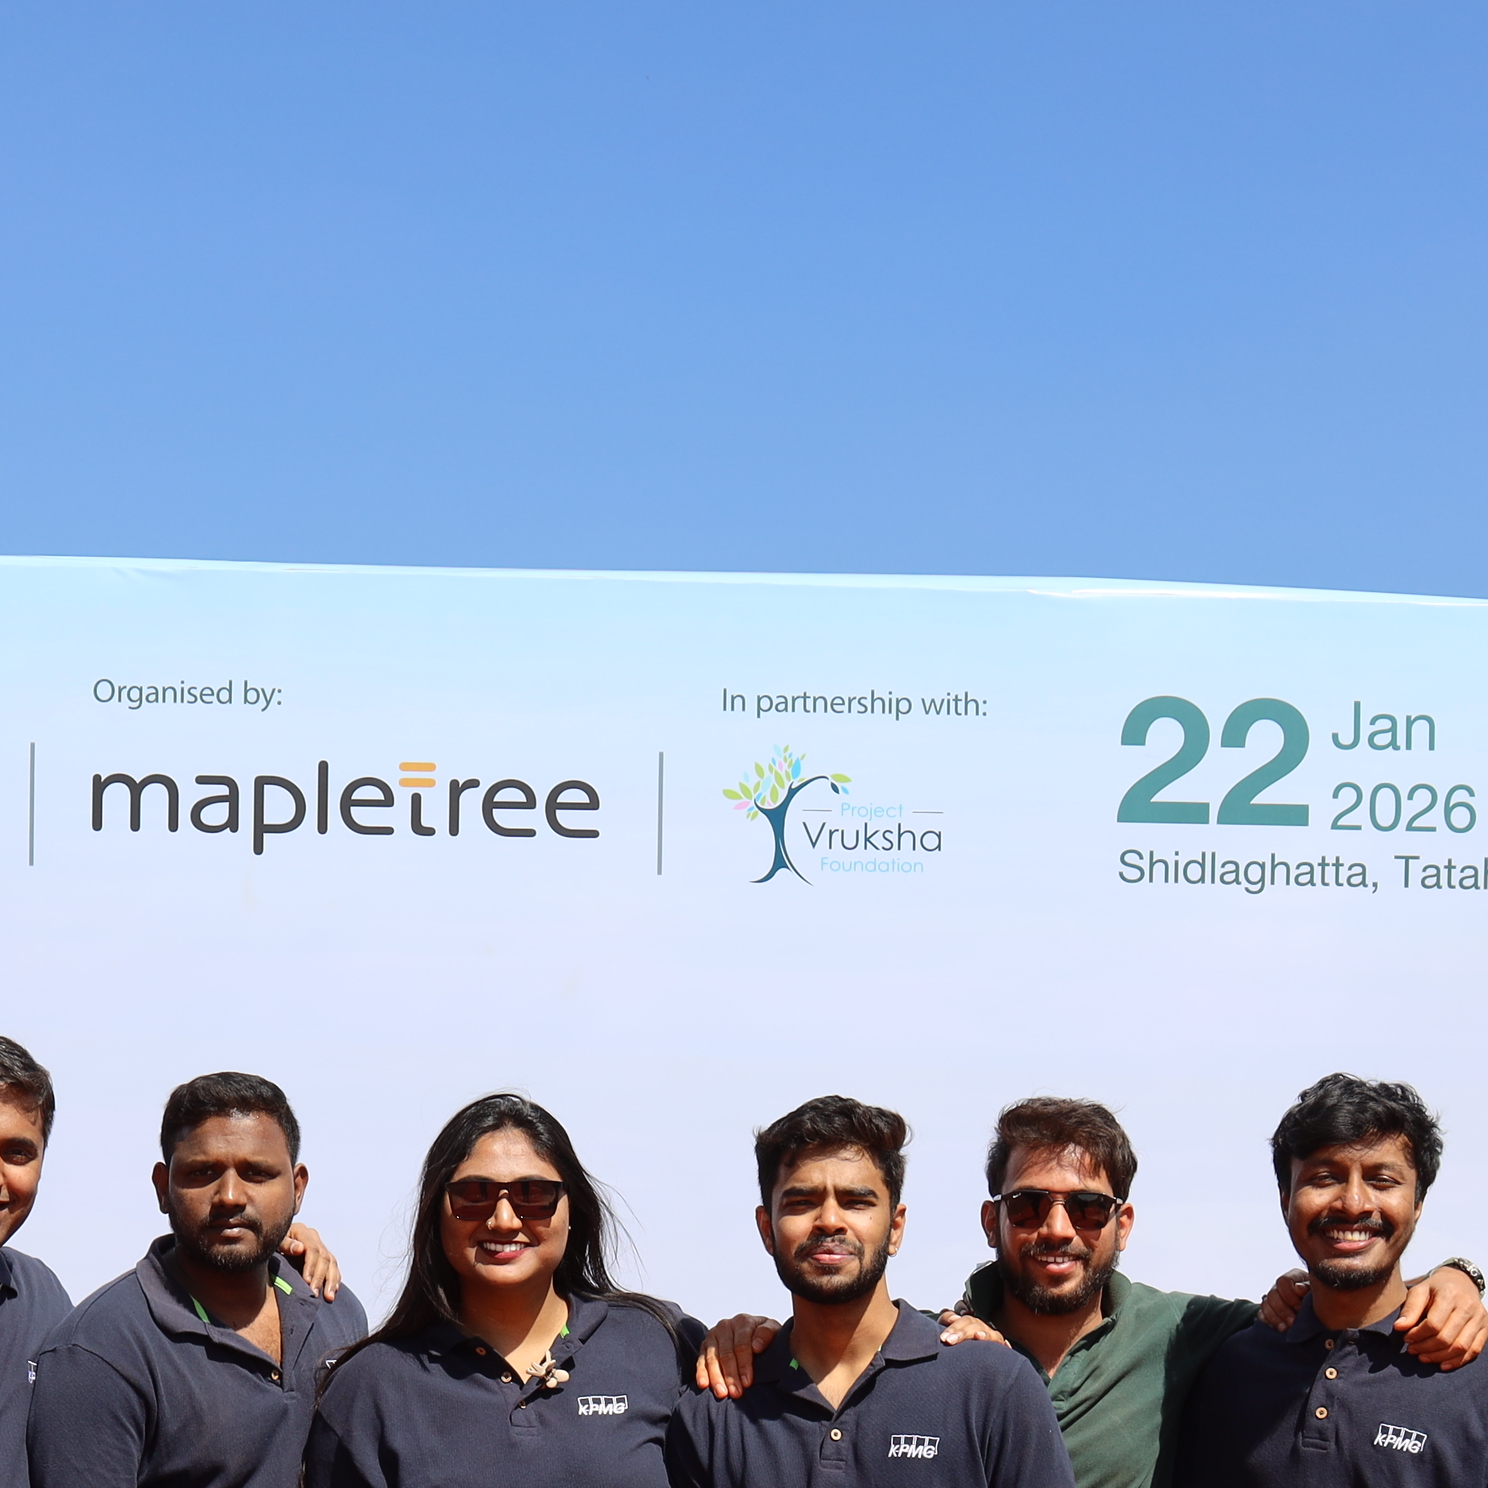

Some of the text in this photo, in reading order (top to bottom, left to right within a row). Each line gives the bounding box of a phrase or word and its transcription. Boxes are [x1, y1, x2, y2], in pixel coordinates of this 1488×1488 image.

[92, 678, 283, 713] Organised by:
[722, 687, 988, 722] In partnership with:
[1331, 700, 1436, 752] Jan
[1116, 695, 1310, 827] 22
[91, 759, 601, 856] mapletree
[840, 802, 904, 822] Project
[1330, 781, 1477, 834] 2026
[802, 821, 942, 853] Vruksha
[820, 856, 925, 874] Foundation
[1118, 848, 1379, 895] Shidlaghatta,
[577, 1401, 627, 1416] KPMG
[887, 1442, 937, 1459] KPMG
[1373, 1431, 1423, 1454] KPMG
